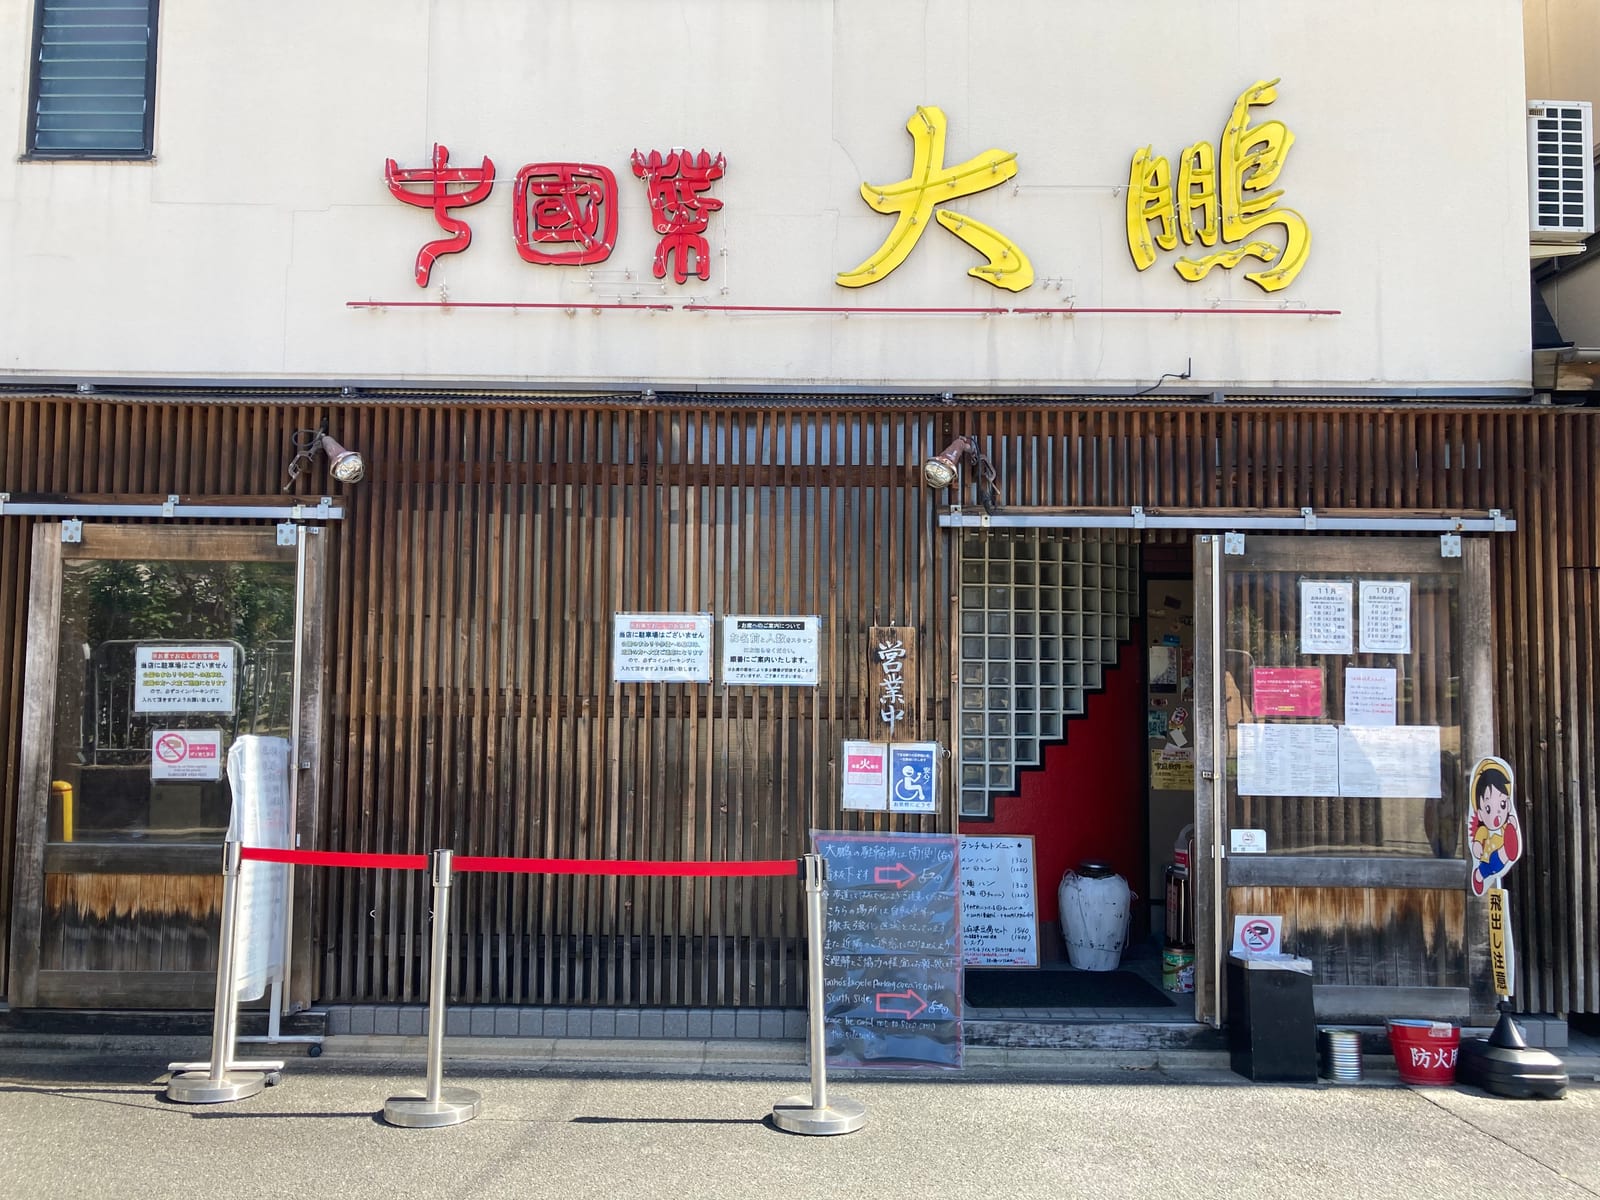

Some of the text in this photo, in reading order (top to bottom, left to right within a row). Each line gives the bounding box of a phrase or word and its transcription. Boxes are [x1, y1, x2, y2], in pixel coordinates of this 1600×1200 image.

[835, 77, 1312, 293] 大鵬
[878, 640, 906, 737] 営業中
[1490, 894, 1507, 990] 飛出し注意
